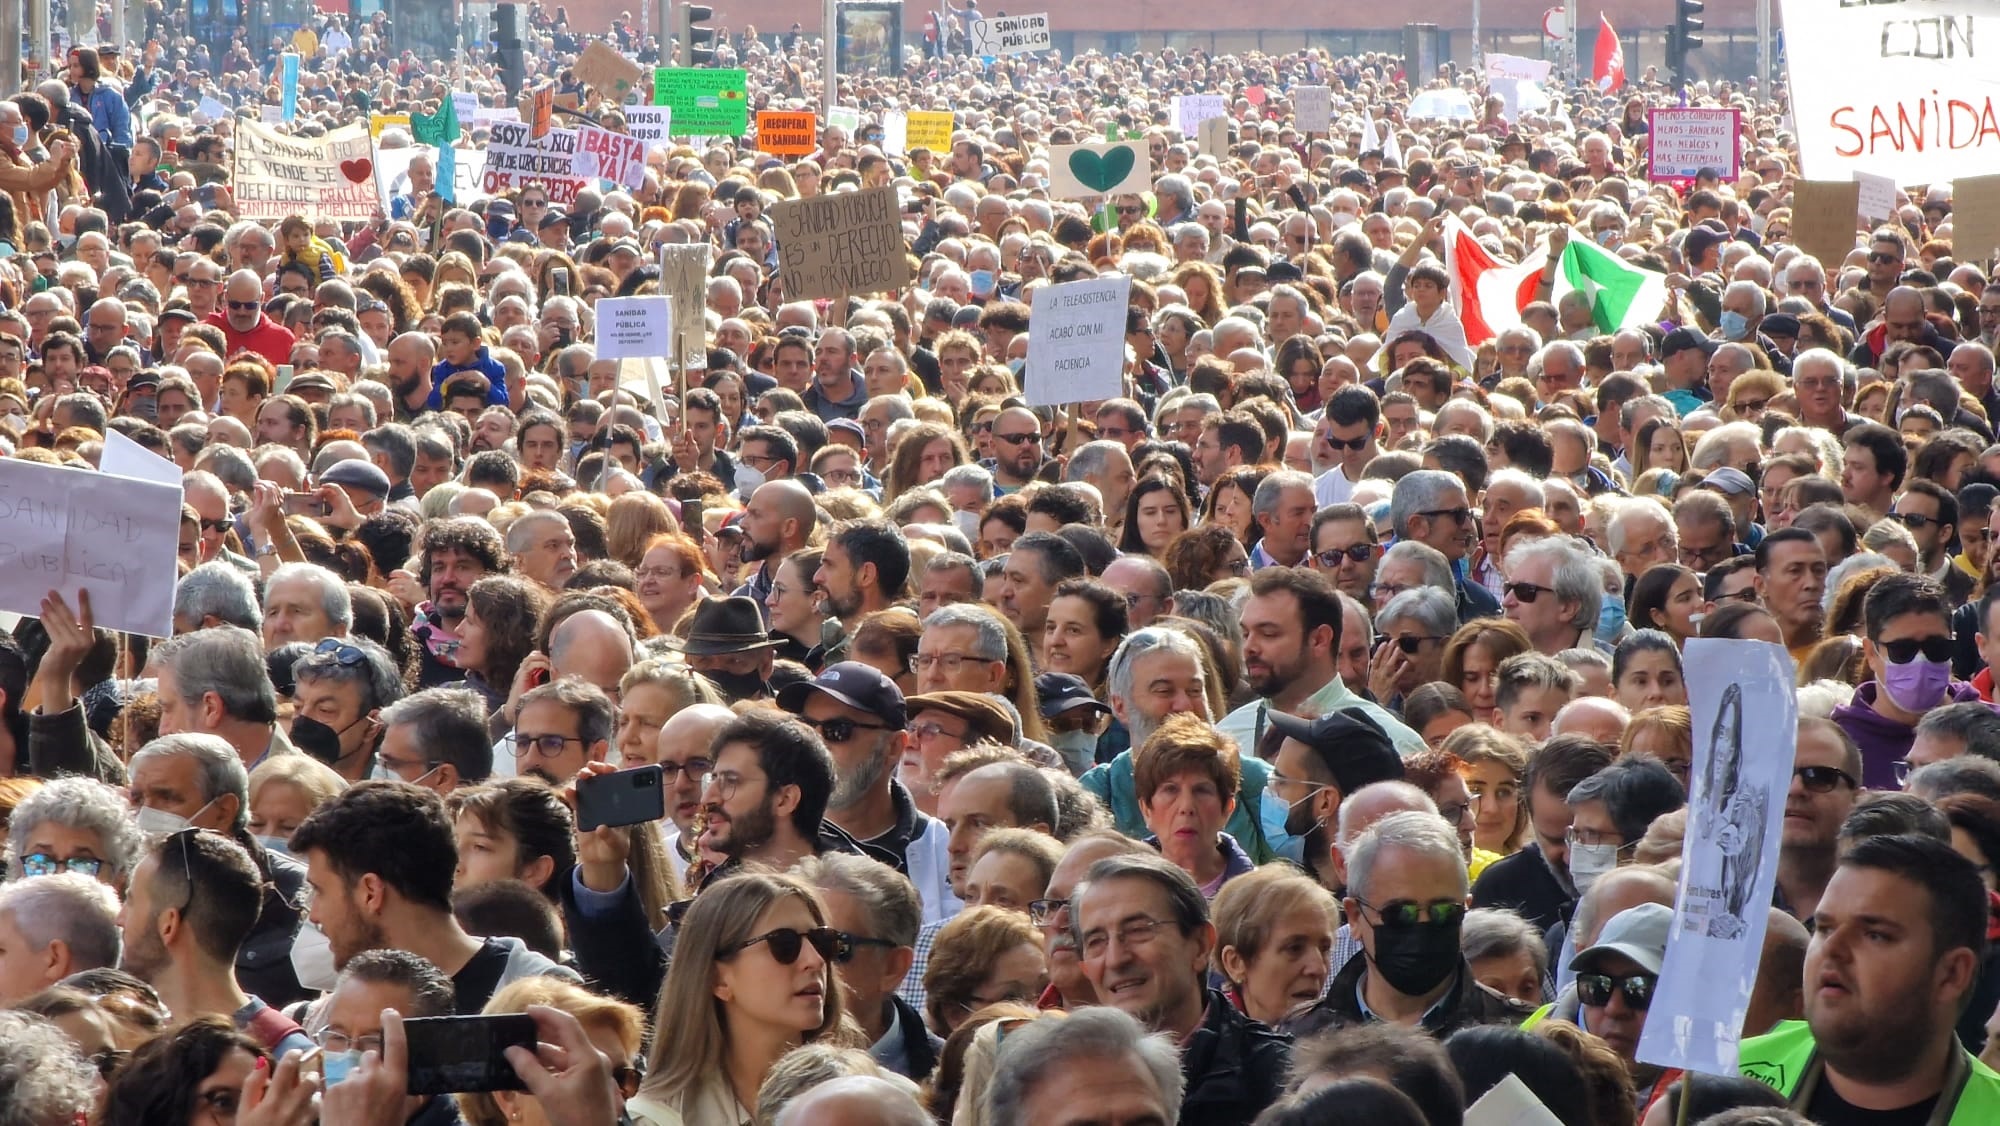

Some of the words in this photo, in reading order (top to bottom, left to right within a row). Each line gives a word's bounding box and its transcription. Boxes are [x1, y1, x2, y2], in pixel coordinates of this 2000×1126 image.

[1881, 15, 1974, 59] CON
[238, 132, 254, 153] LA
[262, 138, 324, 161] SANIDAD
[490, 124, 527, 148] SOY
[576, 127, 643, 163] ¡BASTA
[760, 134, 771, 146] TU
[237, 158, 257, 175] SE
[263, 161, 309, 182] VENDE
[315, 166, 337, 183] SE
[237, 181, 313, 202] DEFIENDE
[319, 183, 377, 203] GRACIAS
[518, 175, 586, 204] EPER
[237, 200, 309, 217] SANITARIOS
[789, 200, 840, 238] SANIDAD
[784, 242, 805, 268] ES
[828, 223, 896, 265] DERECHO
[783, 269, 803, 298] NO
[820, 259, 892, 295] PRIVILEGIO
[1049, 297, 1058, 310] LA
[1063, 289, 1117, 308] TELEASISTENCIA
[615, 309, 647, 317] SANIDAD
[1077, 324, 1092, 337] CON
[1093, 322, 1103, 335] MI
[1054, 356, 1091, 371] PACIENCIA
